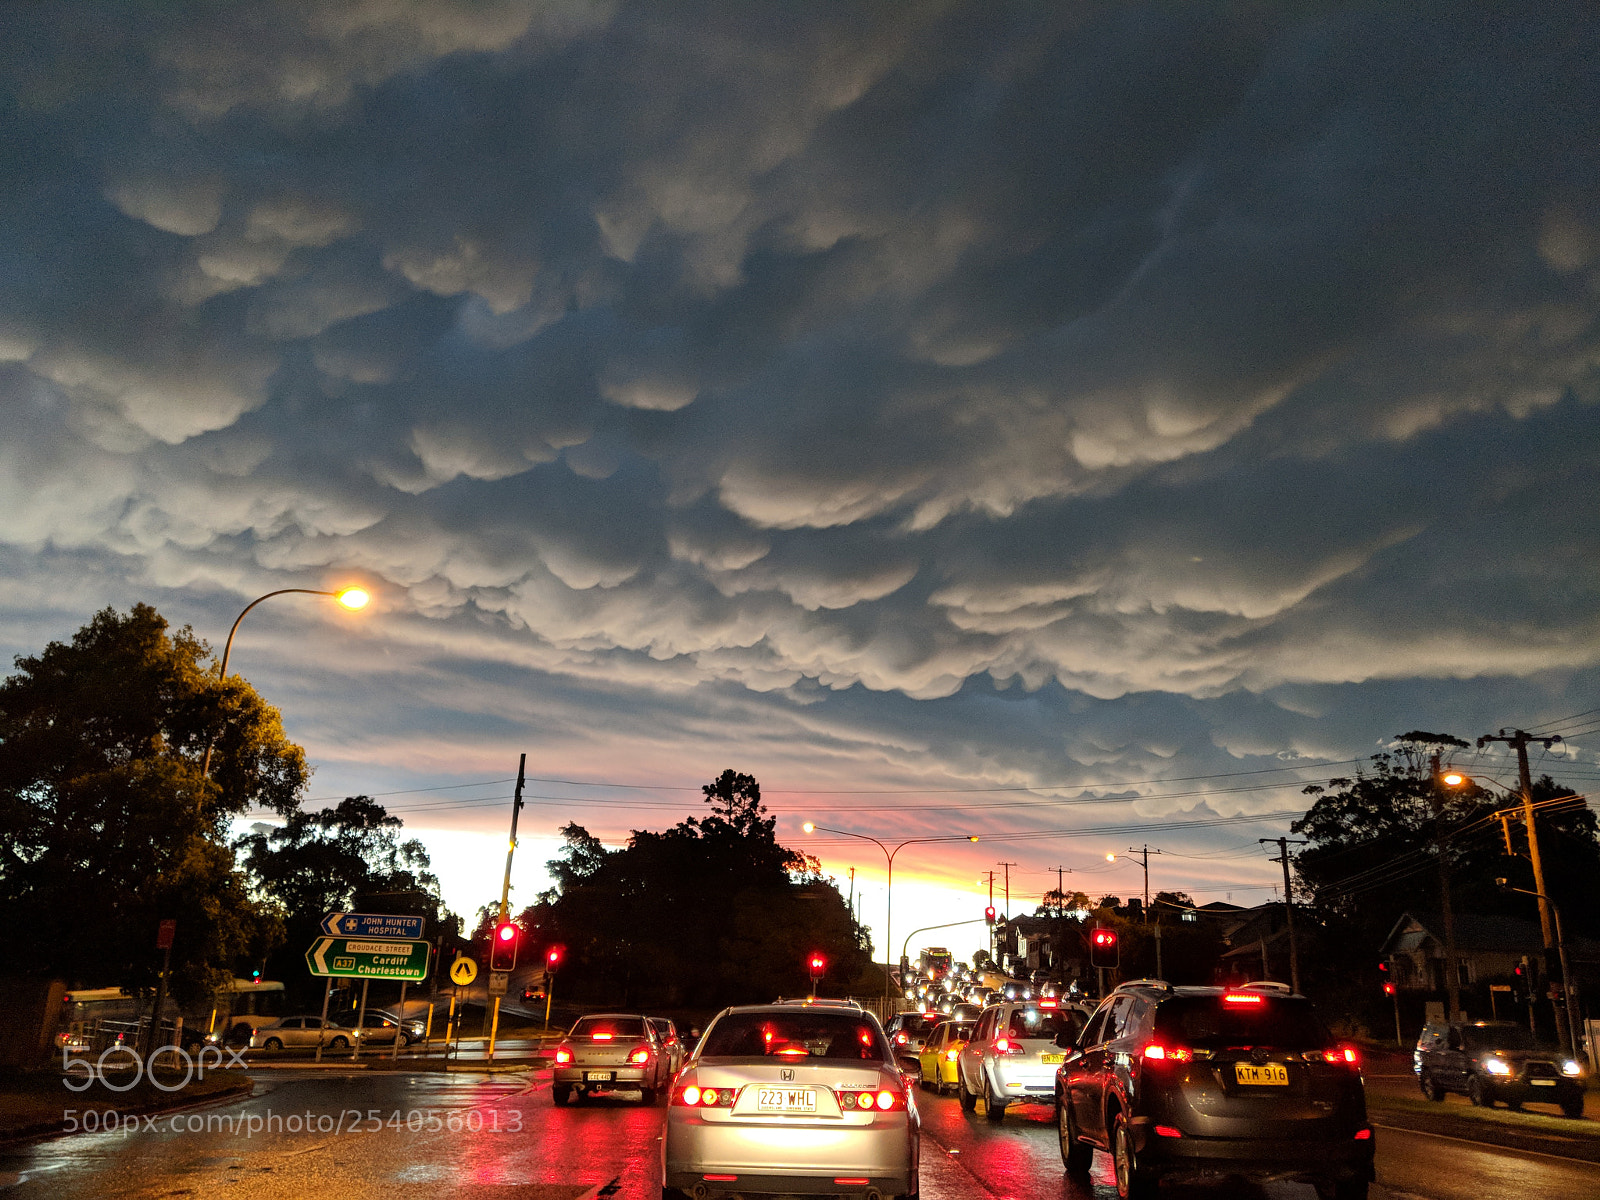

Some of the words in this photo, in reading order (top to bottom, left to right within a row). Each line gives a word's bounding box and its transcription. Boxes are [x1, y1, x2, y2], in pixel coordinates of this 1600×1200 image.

[361, 917, 383, 926] JOHN
[385, 918, 418, 927] HUNTER
[368, 926, 407, 936] HOSPITAL
[348, 944, 383, 952] CROUDACE
[336, 959, 353, 968] A37
[372, 955, 408, 966] Cardiff
[357, 965, 420, 976] Charlestown
[1237, 1067, 1259, 1080] KTM
[1264, 1067, 1286, 1080] 916
[761, 1091, 783, 1105] 223
[788, 1091, 814, 1106] WHL
